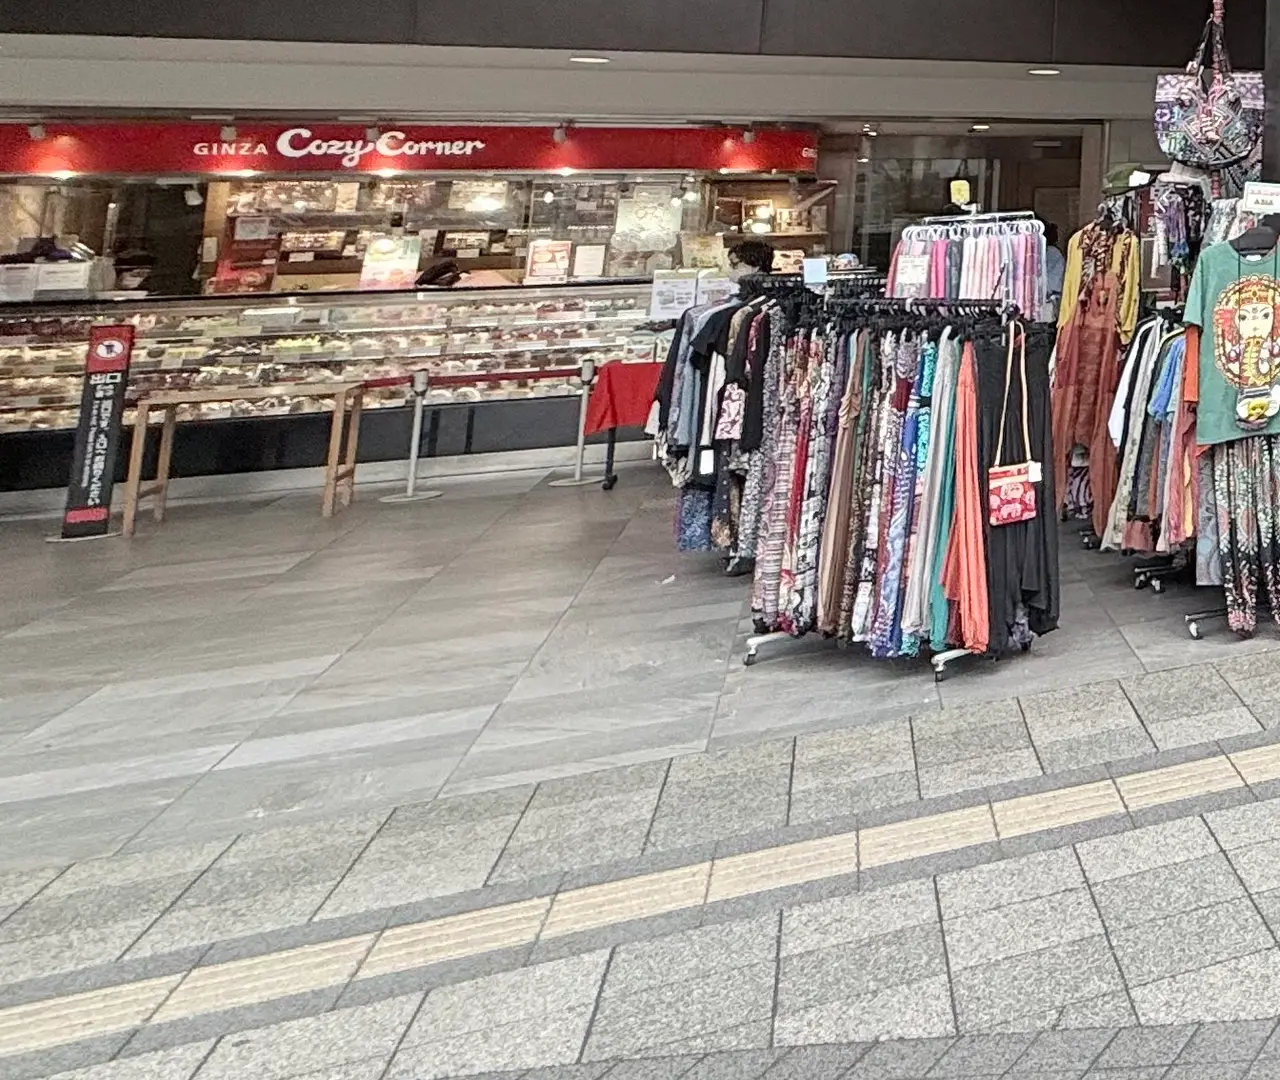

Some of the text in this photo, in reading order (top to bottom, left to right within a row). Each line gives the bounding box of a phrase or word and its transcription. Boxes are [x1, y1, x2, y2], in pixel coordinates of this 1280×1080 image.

[193, 127, 485, 168] GINZA Cozy Corner
